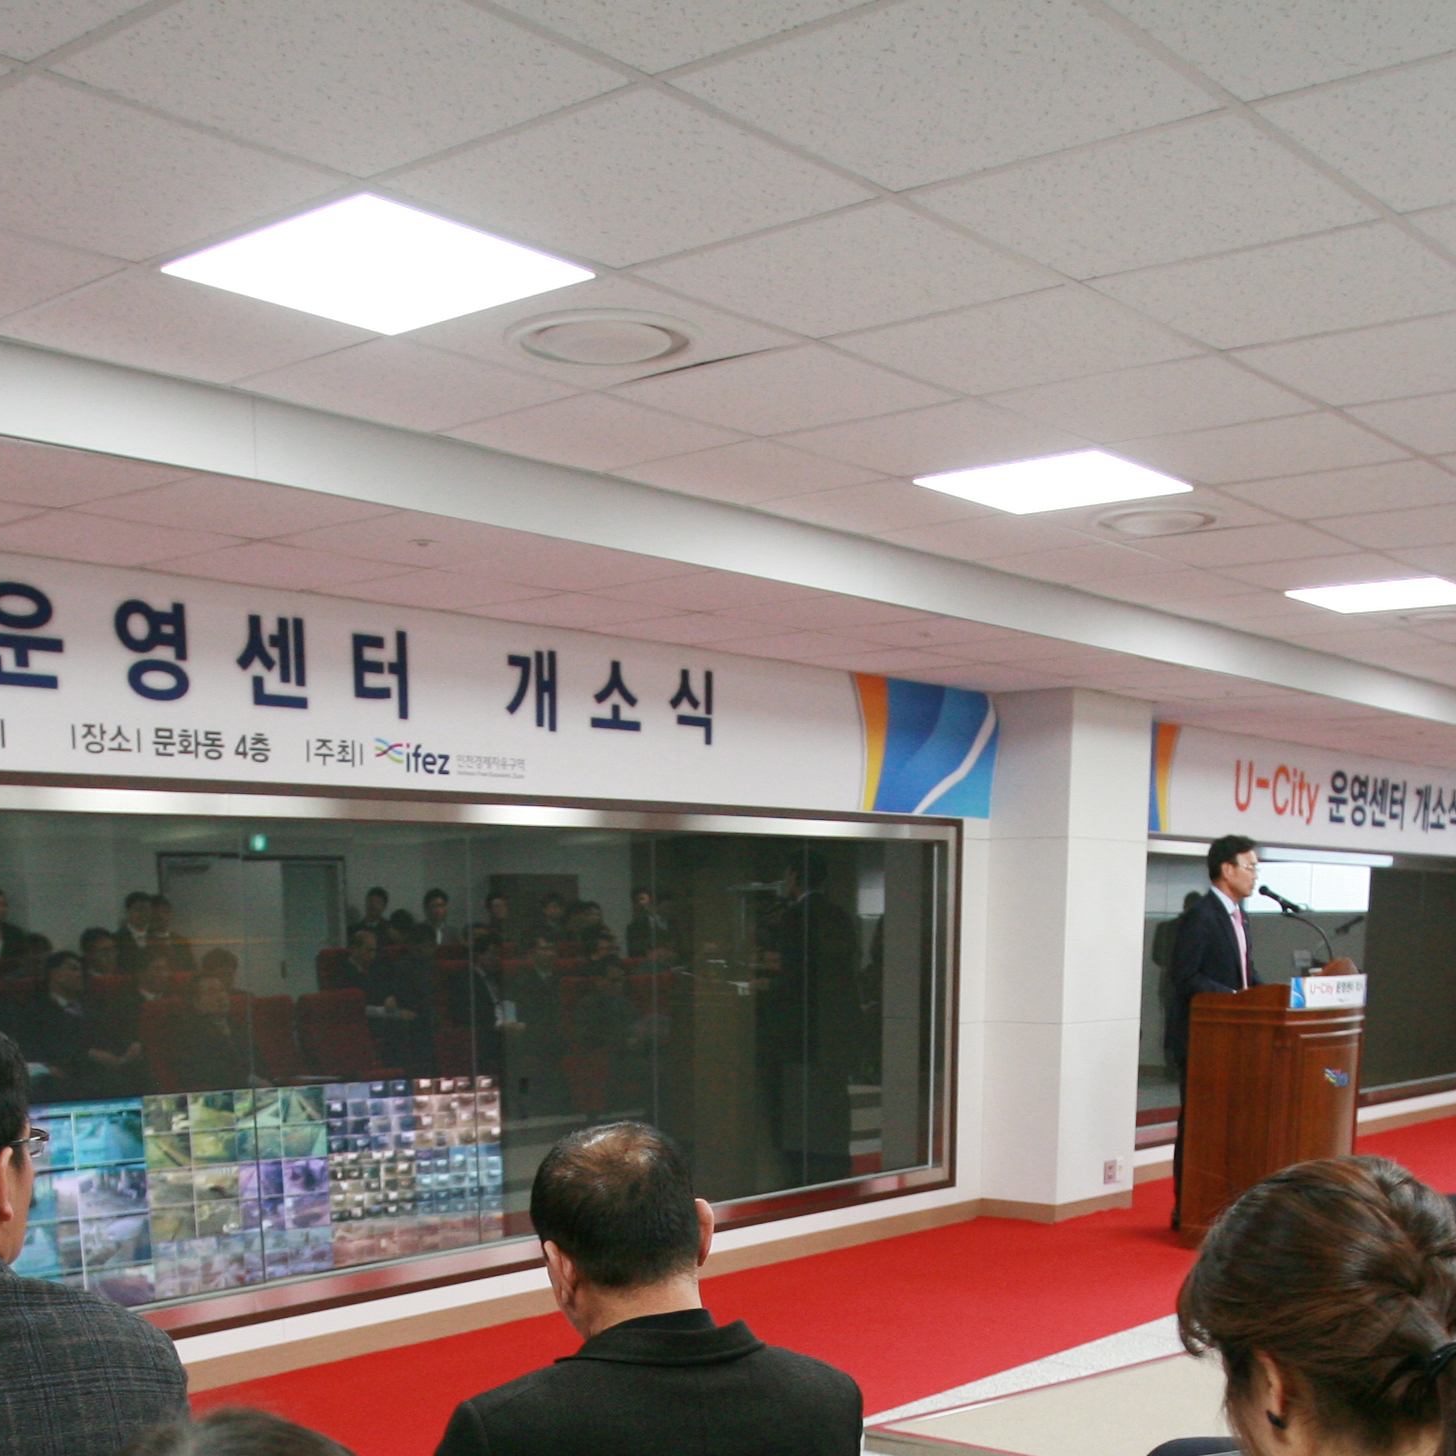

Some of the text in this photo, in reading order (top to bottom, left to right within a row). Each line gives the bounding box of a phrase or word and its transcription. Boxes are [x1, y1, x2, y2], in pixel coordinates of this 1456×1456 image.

[506, 647, 715, 746] 개소식
[152, 727, 225, 761] 문화동
[234, 733, 271, 763] 4층
[406, 743, 450, 775] ifez
[1235, 759, 1320, 825] U-City
[1327, 769, 1407, 830] 운영센터
